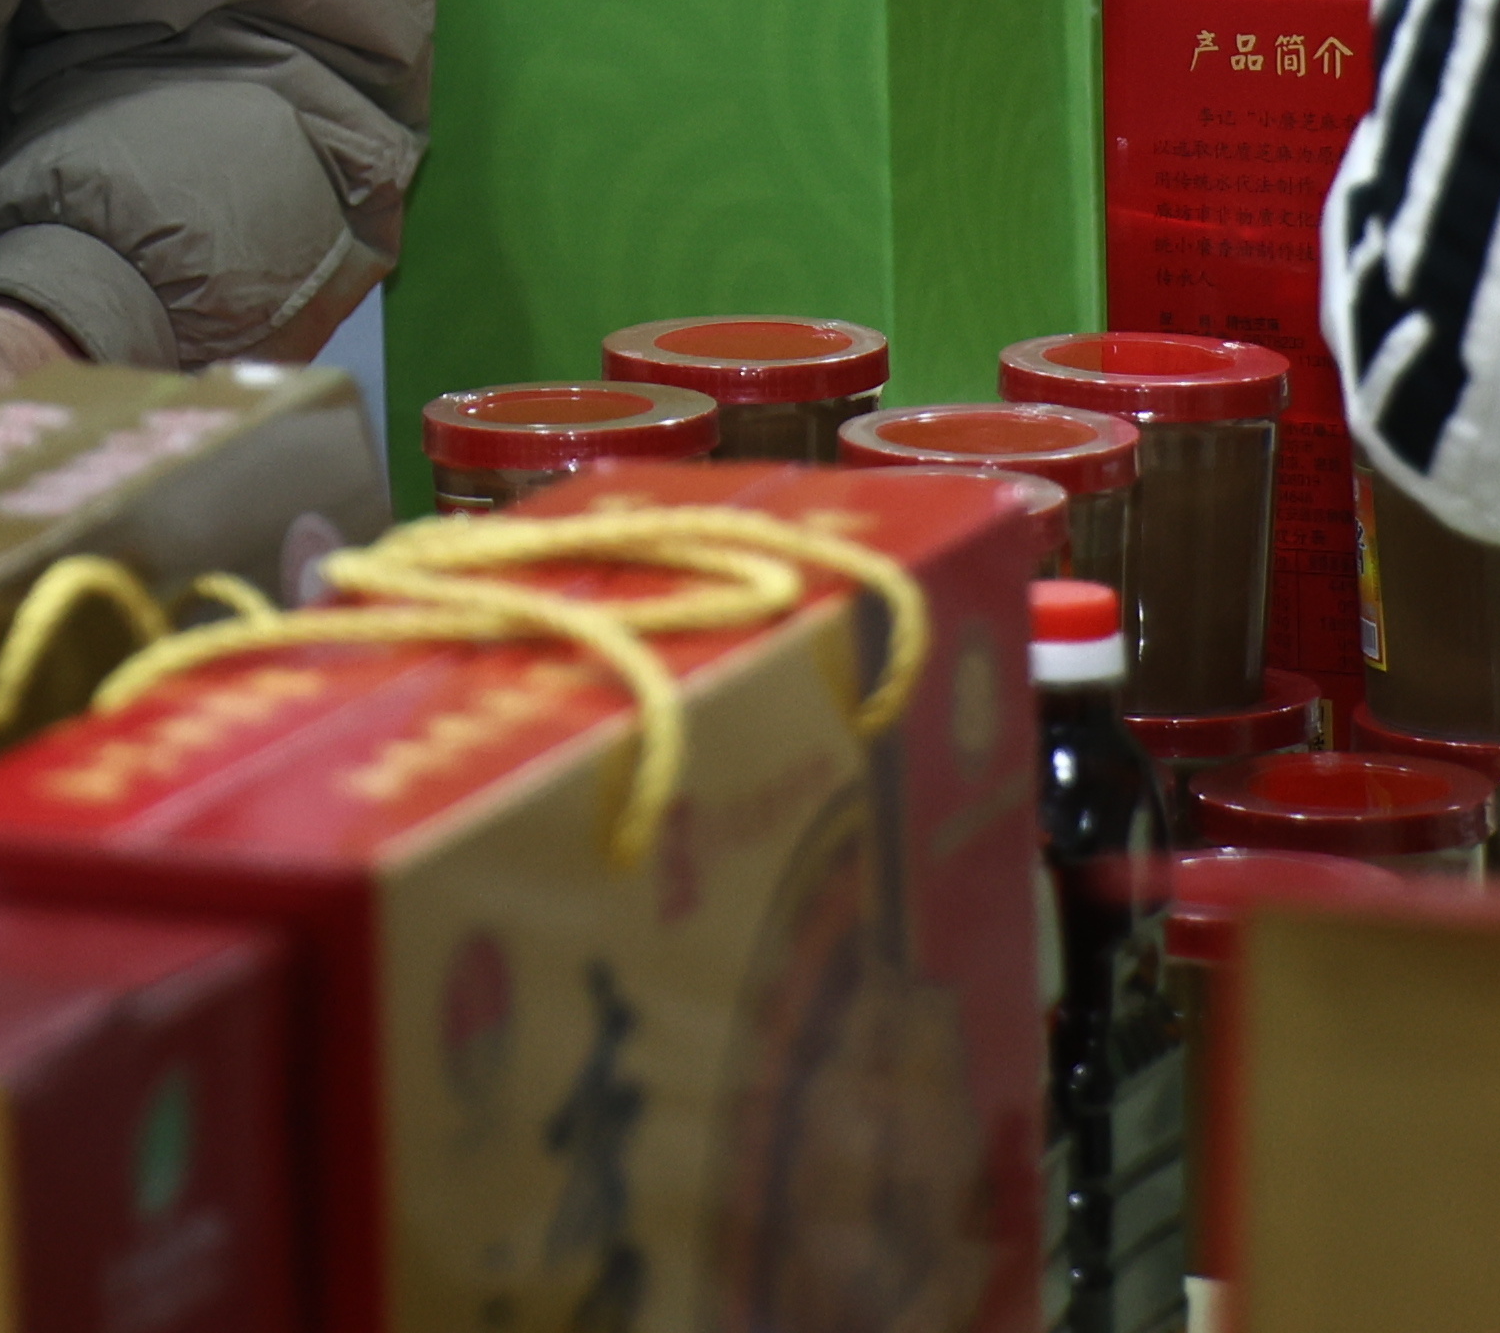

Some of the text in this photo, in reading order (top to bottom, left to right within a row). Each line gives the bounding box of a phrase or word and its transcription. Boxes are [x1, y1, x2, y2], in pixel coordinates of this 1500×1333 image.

[1190, 29, 1354, 80] 产品简介
[1156, 203, 1321, 227] 廊坊市非物质文化
